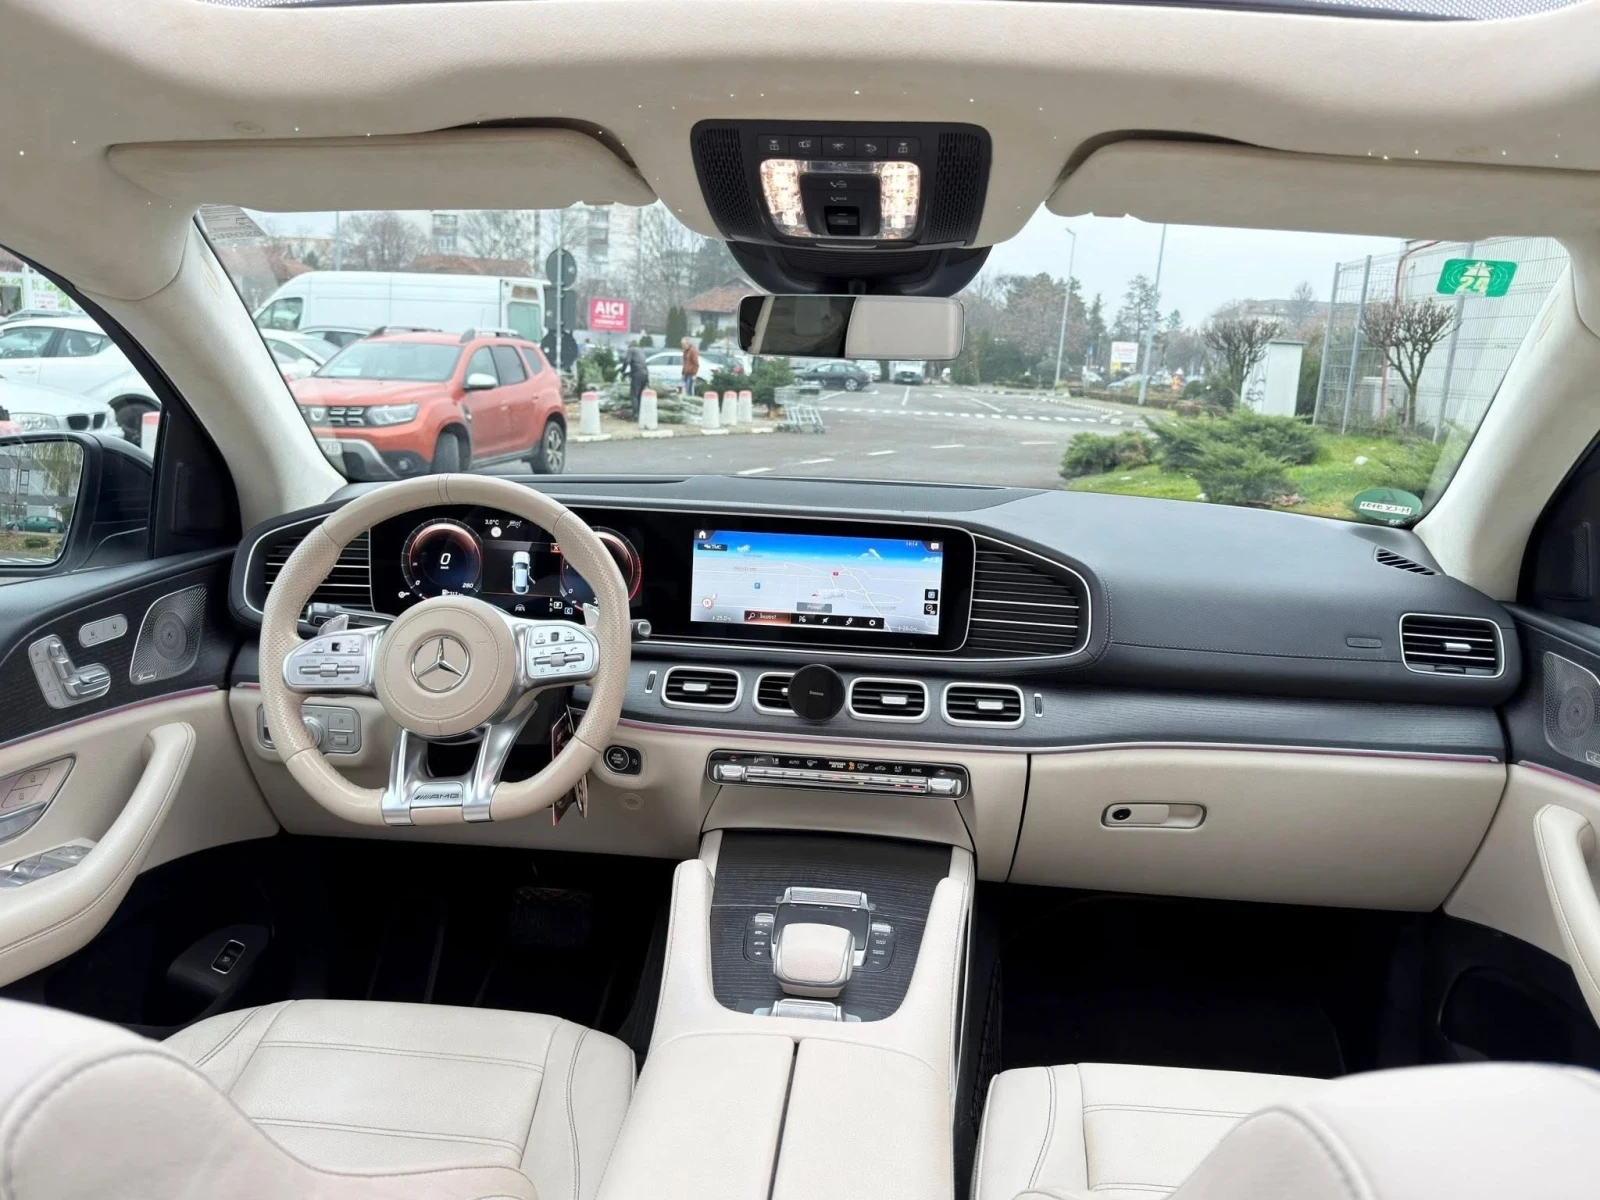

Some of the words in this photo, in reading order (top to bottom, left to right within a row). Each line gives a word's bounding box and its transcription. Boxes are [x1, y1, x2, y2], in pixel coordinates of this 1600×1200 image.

[1454, 276, 1490, 296] 24
[595, 300, 624, 316] AICI
[439, 552, 452, 565] 0
